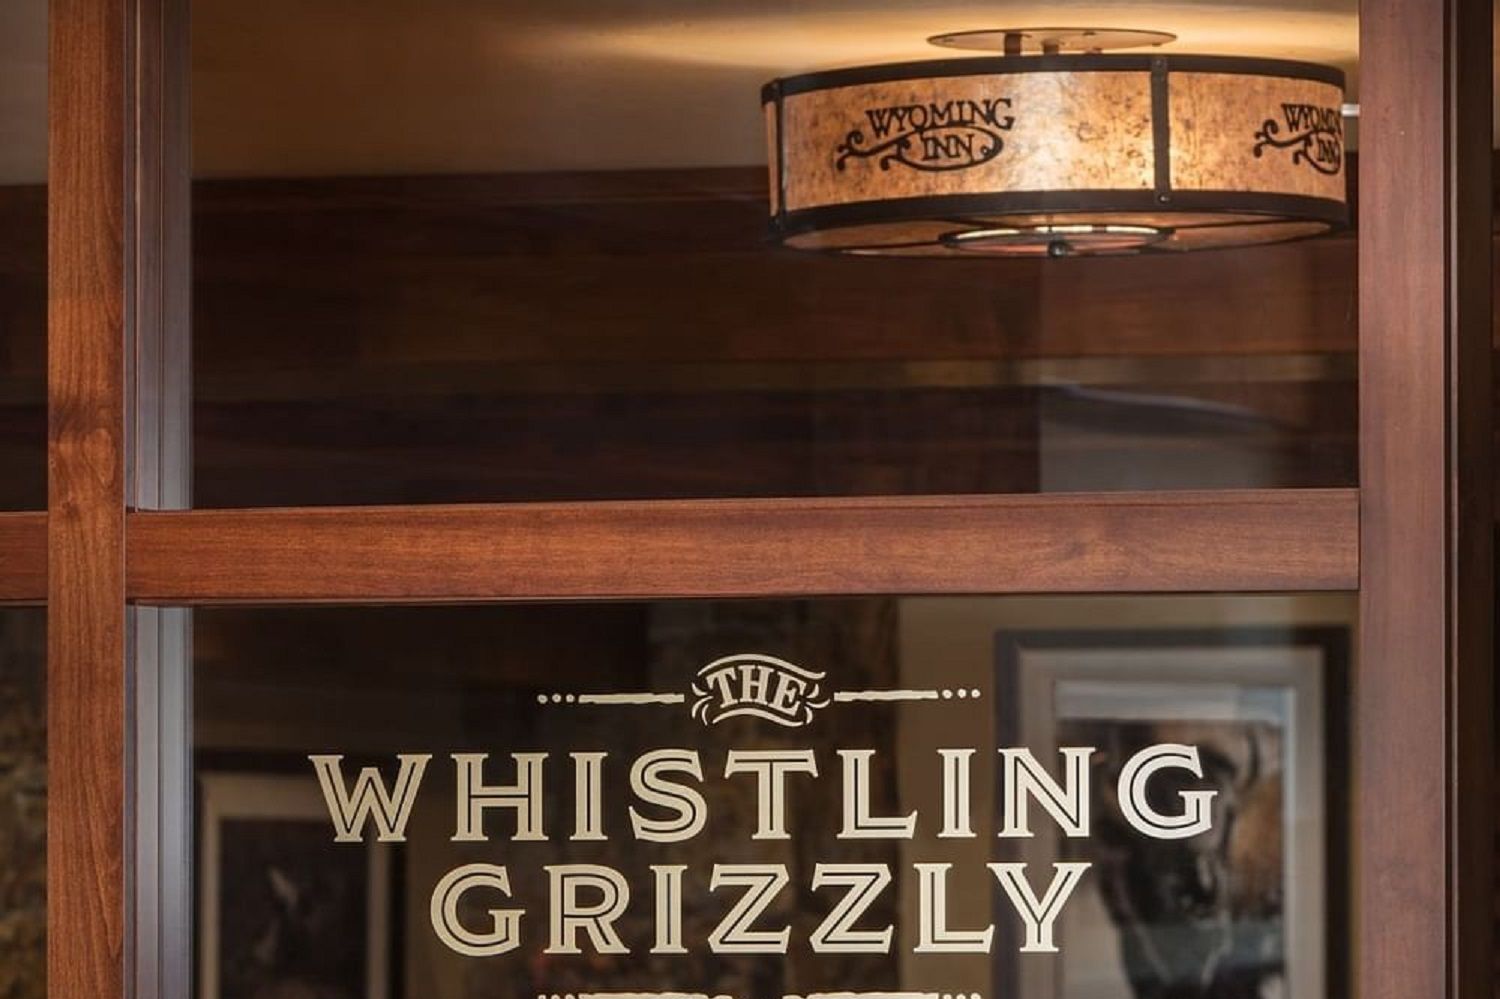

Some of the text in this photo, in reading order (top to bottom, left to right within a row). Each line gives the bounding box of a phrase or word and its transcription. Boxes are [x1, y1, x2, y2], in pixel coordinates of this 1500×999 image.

[865, 98, 1015, 138] WYOMING
[921, 133, 975, 163] INN
[706, 664, 807, 716] THE
[308, 743, 1218, 843] WHISTLING
[430, 862, 1093, 957] GRIZZLY
